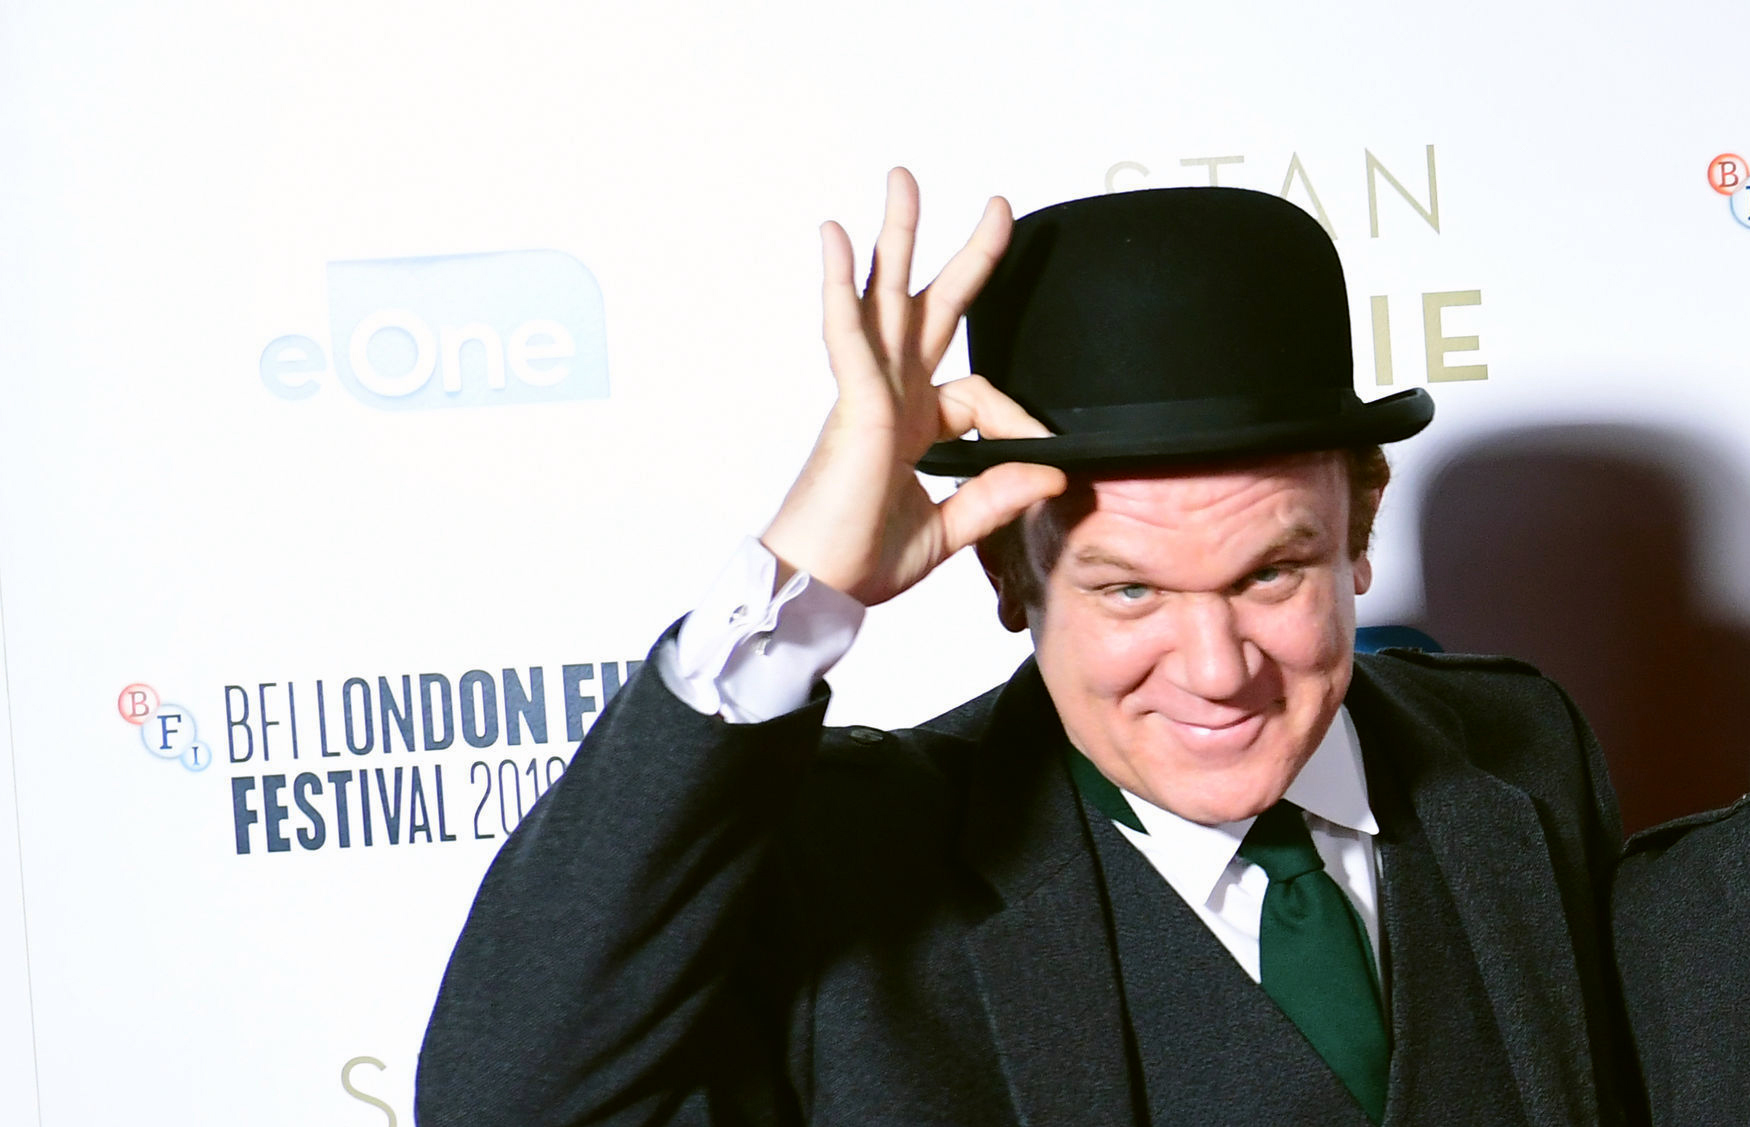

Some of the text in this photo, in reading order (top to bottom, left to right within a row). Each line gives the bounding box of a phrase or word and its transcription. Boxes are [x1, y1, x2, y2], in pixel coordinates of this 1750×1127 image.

[259, 307, 576, 400] eOne
[224, 681, 299, 764] BFI
[316, 666, 547, 757] LONDON
[230, 765, 457, 855] FESTIVAL
